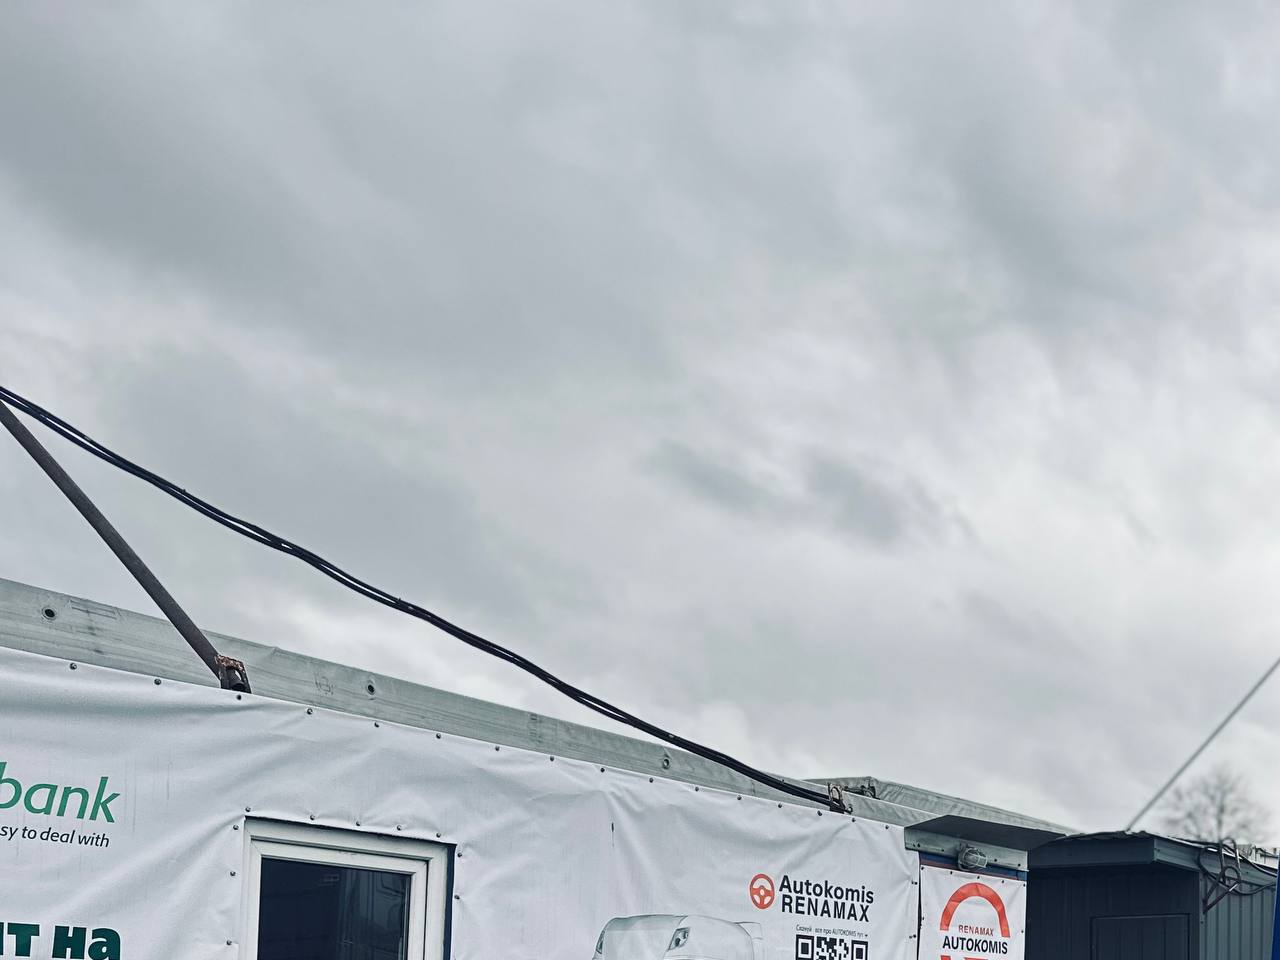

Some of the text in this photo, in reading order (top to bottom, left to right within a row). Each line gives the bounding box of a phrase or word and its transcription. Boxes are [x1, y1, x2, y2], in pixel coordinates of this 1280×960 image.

[21, 826, 37, 840] to
[40, 827, 75, 844] deal
[78, 832, 110, 848] with
[779, 874, 874, 904] Autokomis
[782, 893, 870, 922] RENAMAX
[52, 925, 121, 960] на
[958, 924, 994, 937] RENAMAX
[942, 935, 1008, 955] AUTOKOMIS
